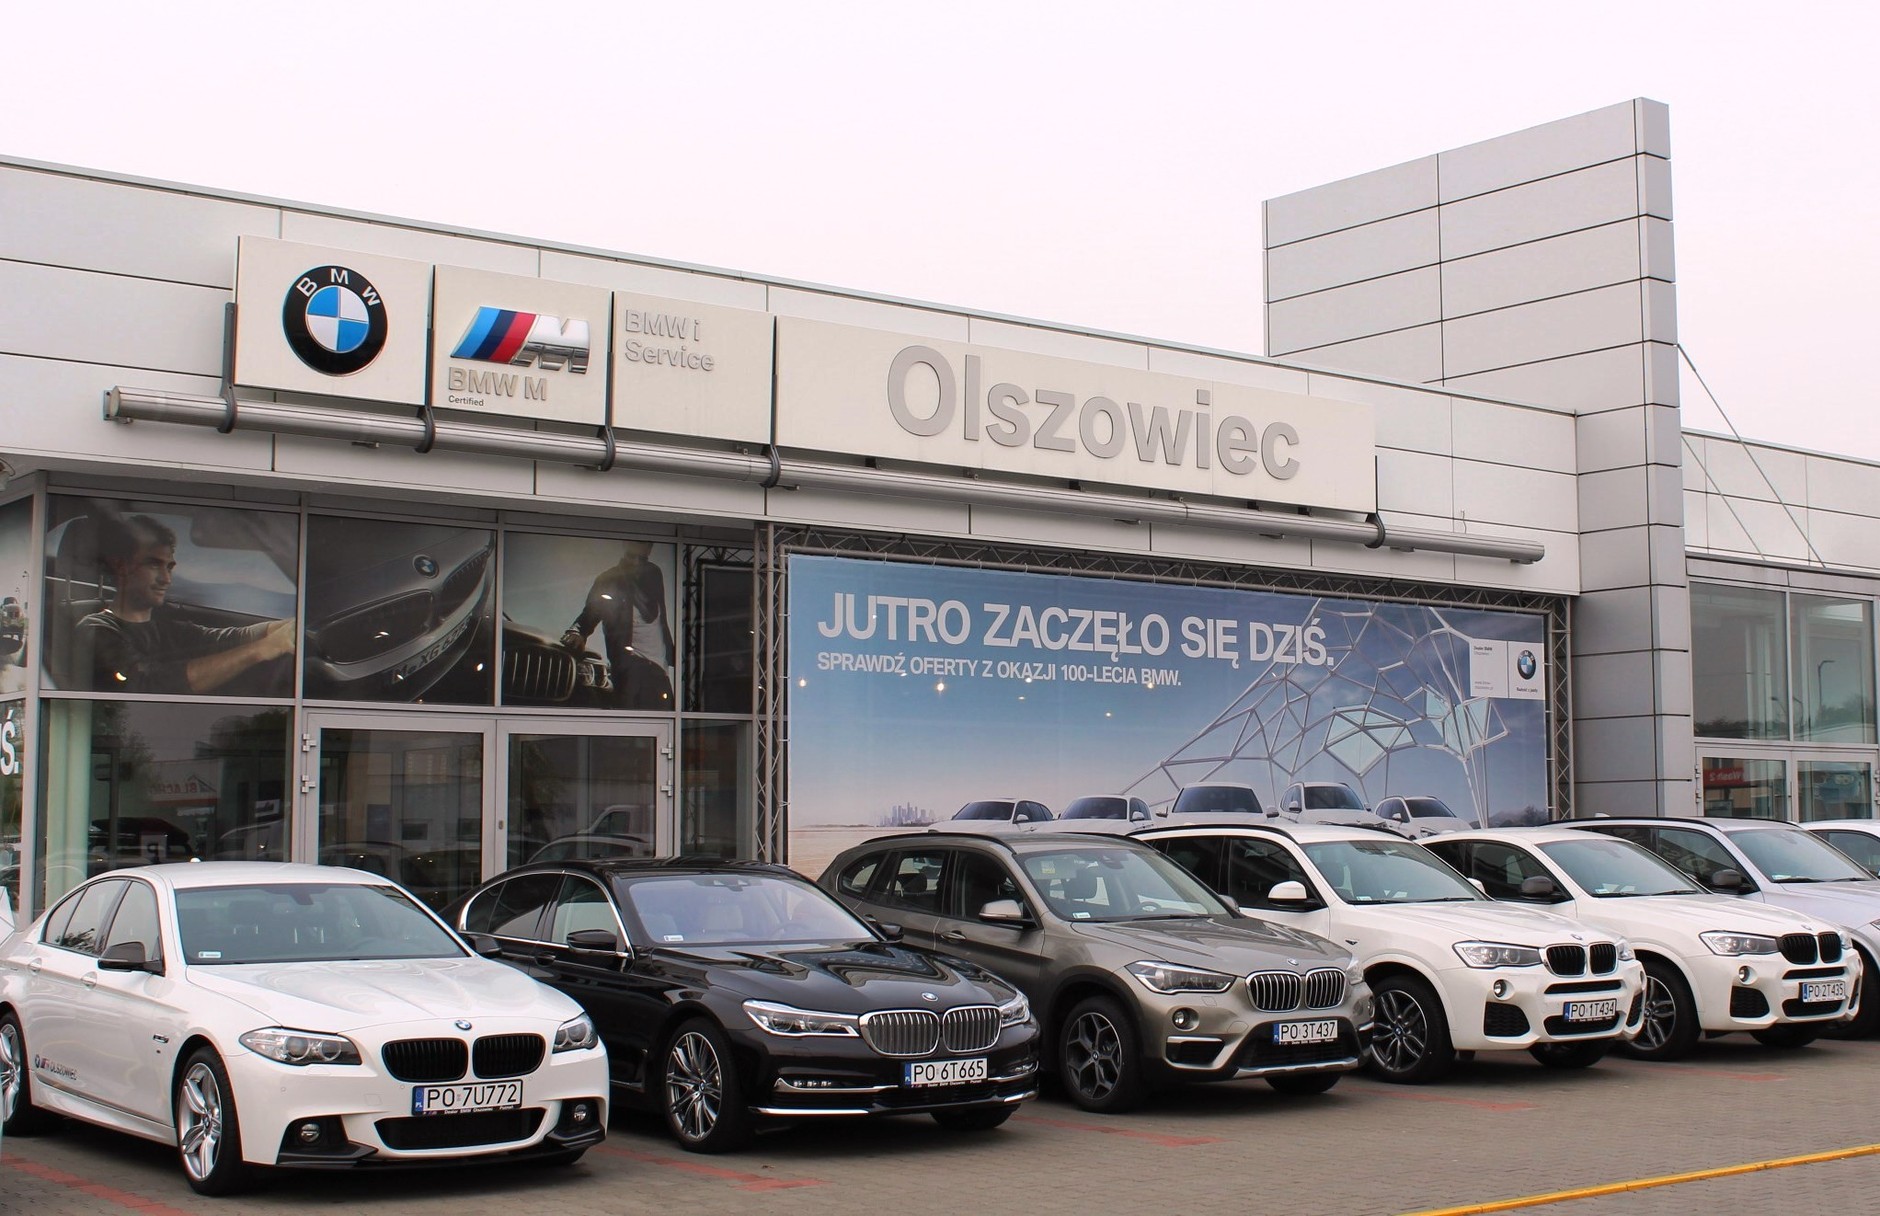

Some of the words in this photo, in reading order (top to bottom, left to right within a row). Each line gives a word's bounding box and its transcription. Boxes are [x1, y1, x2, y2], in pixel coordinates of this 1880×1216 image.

[296, 268, 380, 306] BMW
[625, 309, 686, 339] BMW
[693, 319, 700, 341] i
[625, 338, 714, 371] Service
[449, 367, 519, 397] BMW
[524, 376, 548, 401] M
[448, 395, 485, 407] Certified
[887, 345, 1300, 480] Olszowiec
[817, 592, 971, 645] JUTRO
[983, 603, 1170, 662] ZACZĘŁO
[1180, 616, 1240, 669] SIĘ
[1249, 618, 1334, 666] DZIŚ.
[817, 652, 906, 674] SPRAWDŹ
[910, 657, 978, 677] OFERTY
[982, 660, 993, 678] Z
[997, 661, 1056, 680] OKAZJI
[1060, 665, 1137, 684] 100-LECIA
[1141, 668, 1181, 686] BMW.
[0, 709, 19, 776] Ś.
[1809, 985, 1820, 997] PO
[1822, 984, 1844, 997] 2T435
[1571, 1004, 1585, 1017] PO
[1589, 1002, 1615, 1016] 1T434
[1281, 1024, 1298, 1040] PO
[1302, 1022, 1335, 1039] 3T437
[913, 1064, 935, 1082] PO
[941, 1060, 984, 1079] 6T665
[427, 1088, 455, 1108] PO
[463, 1084, 517, 1107] 7U772
